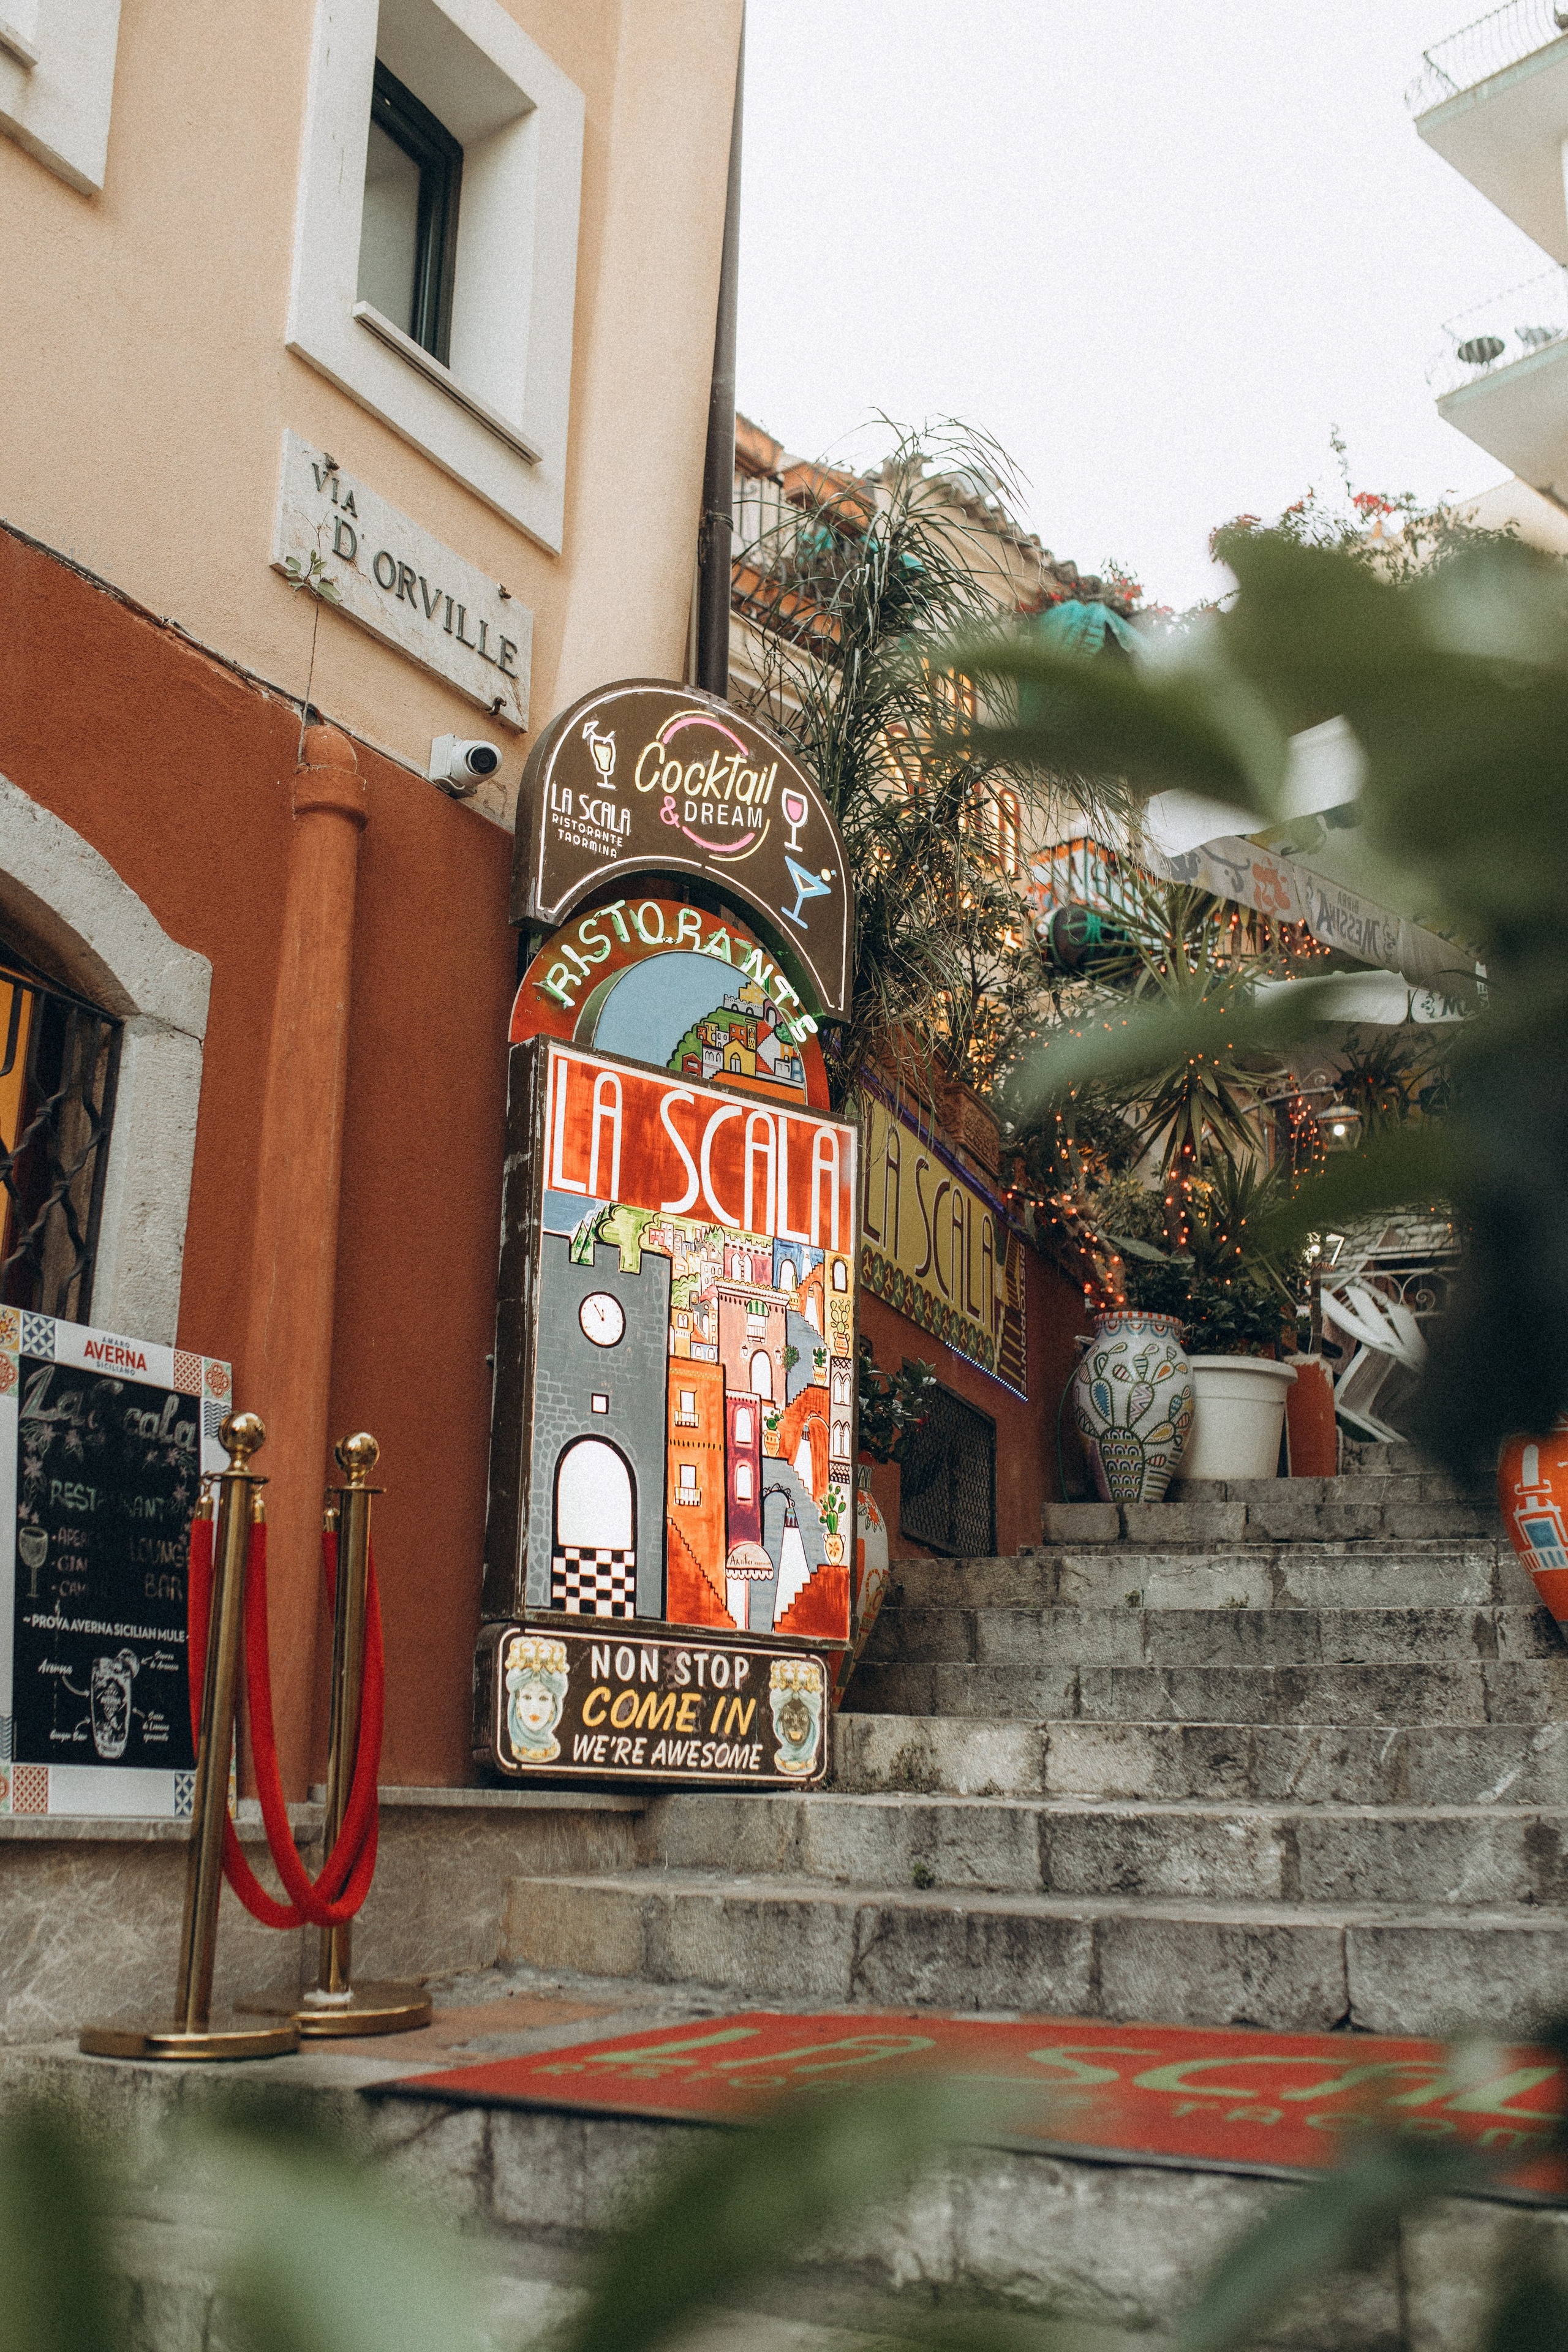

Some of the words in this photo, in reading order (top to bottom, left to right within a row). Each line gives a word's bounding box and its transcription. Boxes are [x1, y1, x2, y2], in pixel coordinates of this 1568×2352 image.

[312, 462, 358, 518] VIA
[551, 781, 573, 815] LA
[579, 794, 631, 837] SCALA
[552, 813, 623, 847] RISTORANTE
[660, 795, 681, 828] &
[684, 800, 763, 828] DREAM
[558, 829, 617, 859] TAORMINA
[545, 899, 819, 1042] RISTORANTE
[551, 1058, 623, 1202] LA
[660, 1089, 840, 1252] SCALA
[862, 1102, 902, 1261] LA
[914, 1155, 996, 1334] SCALA
[1019, 1242, 1028, 1396] RISTORANTE
[83, 1339, 148, 1372] AVERNA
[102, 1336, 130, 1349] AMARO
[96, 1360, 136, 1376] SICILIANO
[31, 1613, 70, 1630] PROVA
[70, 1618, 114, 1636] AVERNA
[113, 1623, 157, 1640] SICILIAN
[157, 1628, 186, 1643] MULE
[590, 1644, 659, 1683] NON
[674, 1651, 750, 1689] STOP
[582, 1686, 701, 1733] COME
[710, 1695, 757, 1736] IN
[572, 1733, 647, 1766] WE'RE
[650, 1738, 764, 1771] AWESOME
[584, 2027, 937, 2074] LA
[946, 2046, 1566, 2120] SCAL
